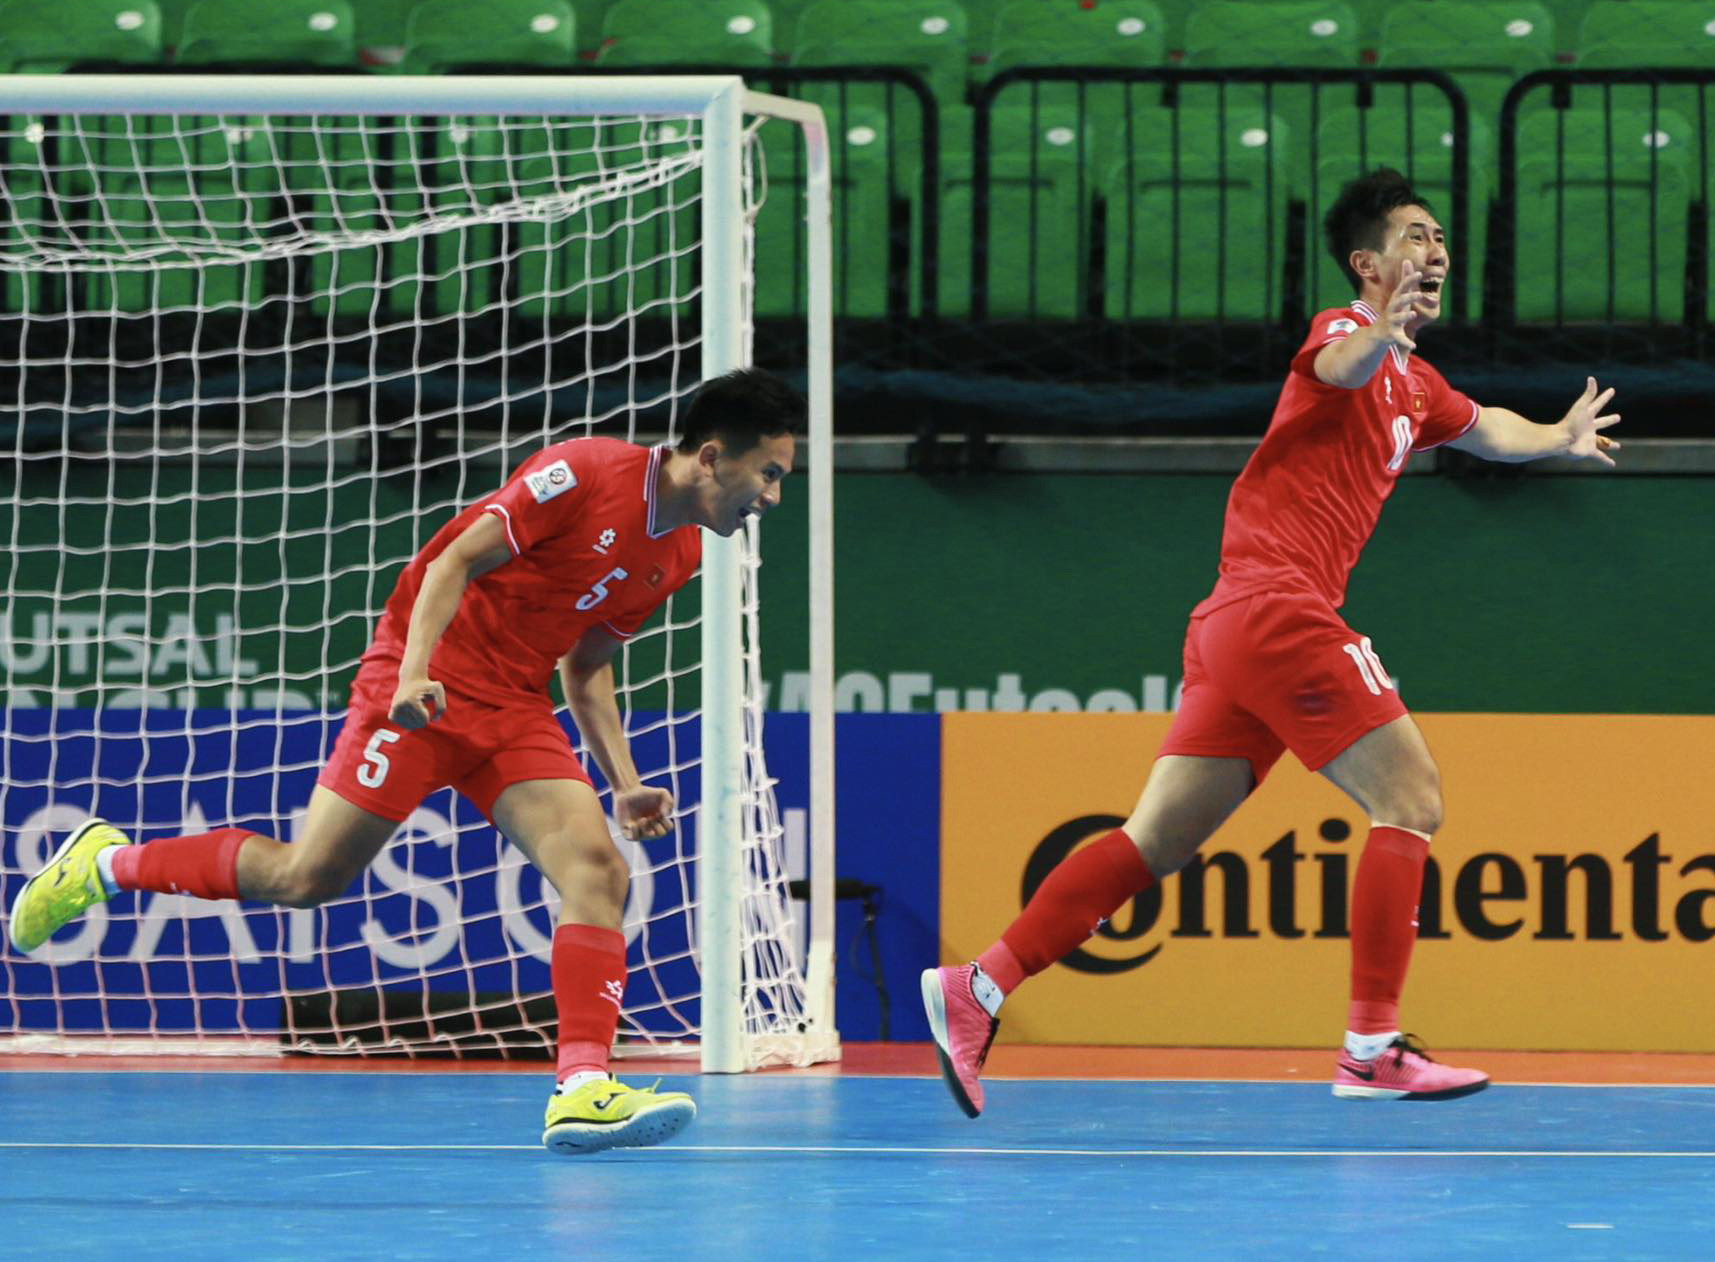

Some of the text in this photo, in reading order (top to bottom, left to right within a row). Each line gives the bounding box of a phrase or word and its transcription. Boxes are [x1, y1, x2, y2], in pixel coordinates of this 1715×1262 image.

[575, 567, 629, 611] 5
[0, 611, 259, 675] UTSAL
[356, 728, 401, 789] 5
